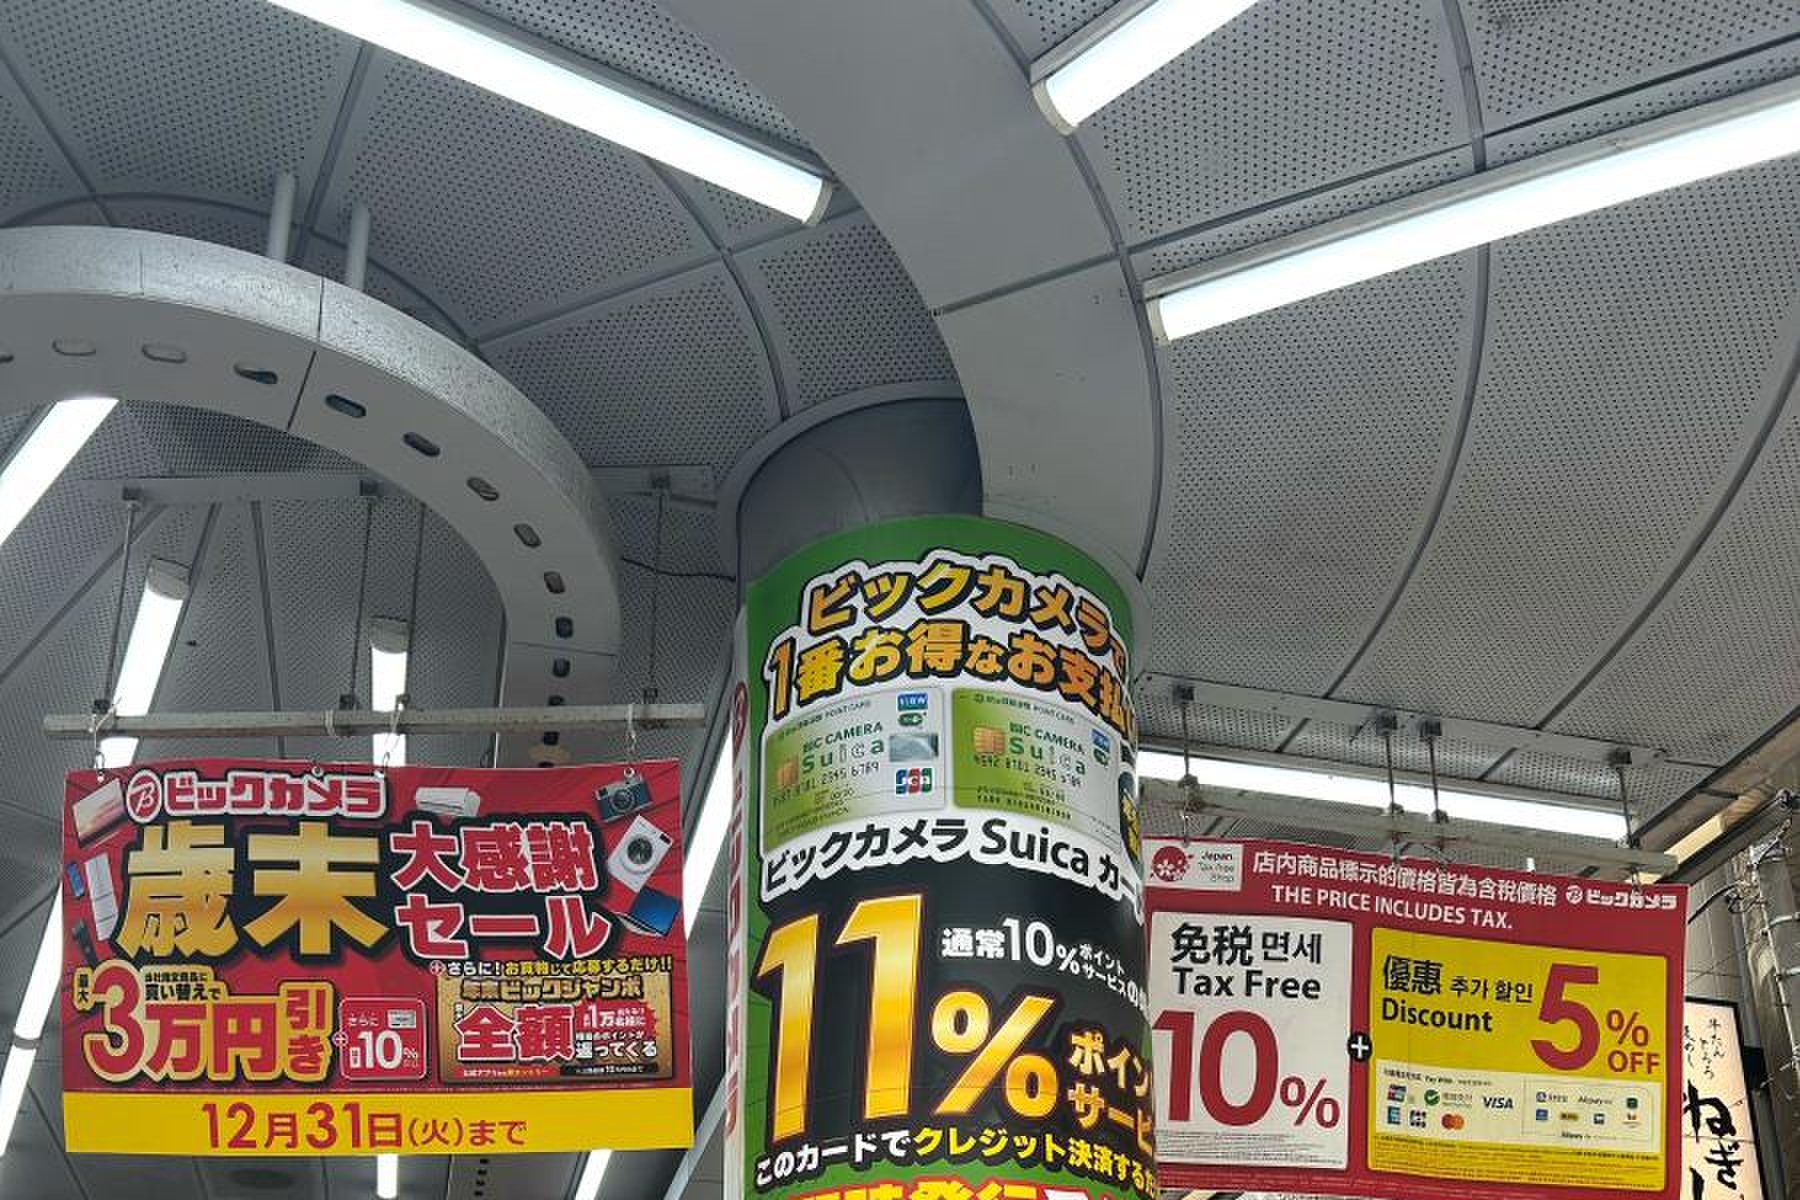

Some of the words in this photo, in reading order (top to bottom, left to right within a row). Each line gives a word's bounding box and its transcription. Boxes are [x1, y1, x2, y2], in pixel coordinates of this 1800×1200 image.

[825, 722, 883, 744] CAMERA
[1034, 729, 1086, 754] CAMERA
[801, 739, 885, 774] Suica
[1009, 737, 1086, 776] Suica
[164, 772, 386, 817] ビックカメラ
[391, 820, 598, 894] 大感謝
[766, 818, 969, 894] ビックカメラ
[979, 819, 1090, 876] Suica
[1201, 850, 1233, 862] Japan
[114, 820, 390, 958] 歳末
[1271, 884, 1312, 905] THE
[1317, 889, 1371, 912] PRICE
[1375, 895, 1466, 925] INCLUDES
[1471, 909, 1514, 930] TAX.
[1586, 888, 1678, 909] ビックカメラ
[395, 894, 613, 958] セール
[1262, 931, 1322, 964] 면세
[1080, 944, 1125, 976] ポイント
[1172, 966, 1234, 997] Tax
[1245, 970, 1321, 999] Free
[1383, 955, 1443, 995] 優惠
[1450, 976, 1489, 1001] 추가
[1495, 979, 1533, 1004] 할인
[145, 983, 221, 1001] 買い替えで
[1382, 997, 1493, 1032] Discount
[86, 965, 277, 1075] 3万円
[286, 988, 326, 1075] 引き
[455, 1003, 575, 1062] 全額
[757, 894, 1058, 1143] 11%
[1069, 1031, 1152, 1098] ポイン
[1151, 1009, 1341, 1129] 10%
[1607, 1050, 1660, 1074] OFF
[1482, 1096, 1513, 1109] VISA
[202, 1101, 527, 1150] 12月31日(火)まで
